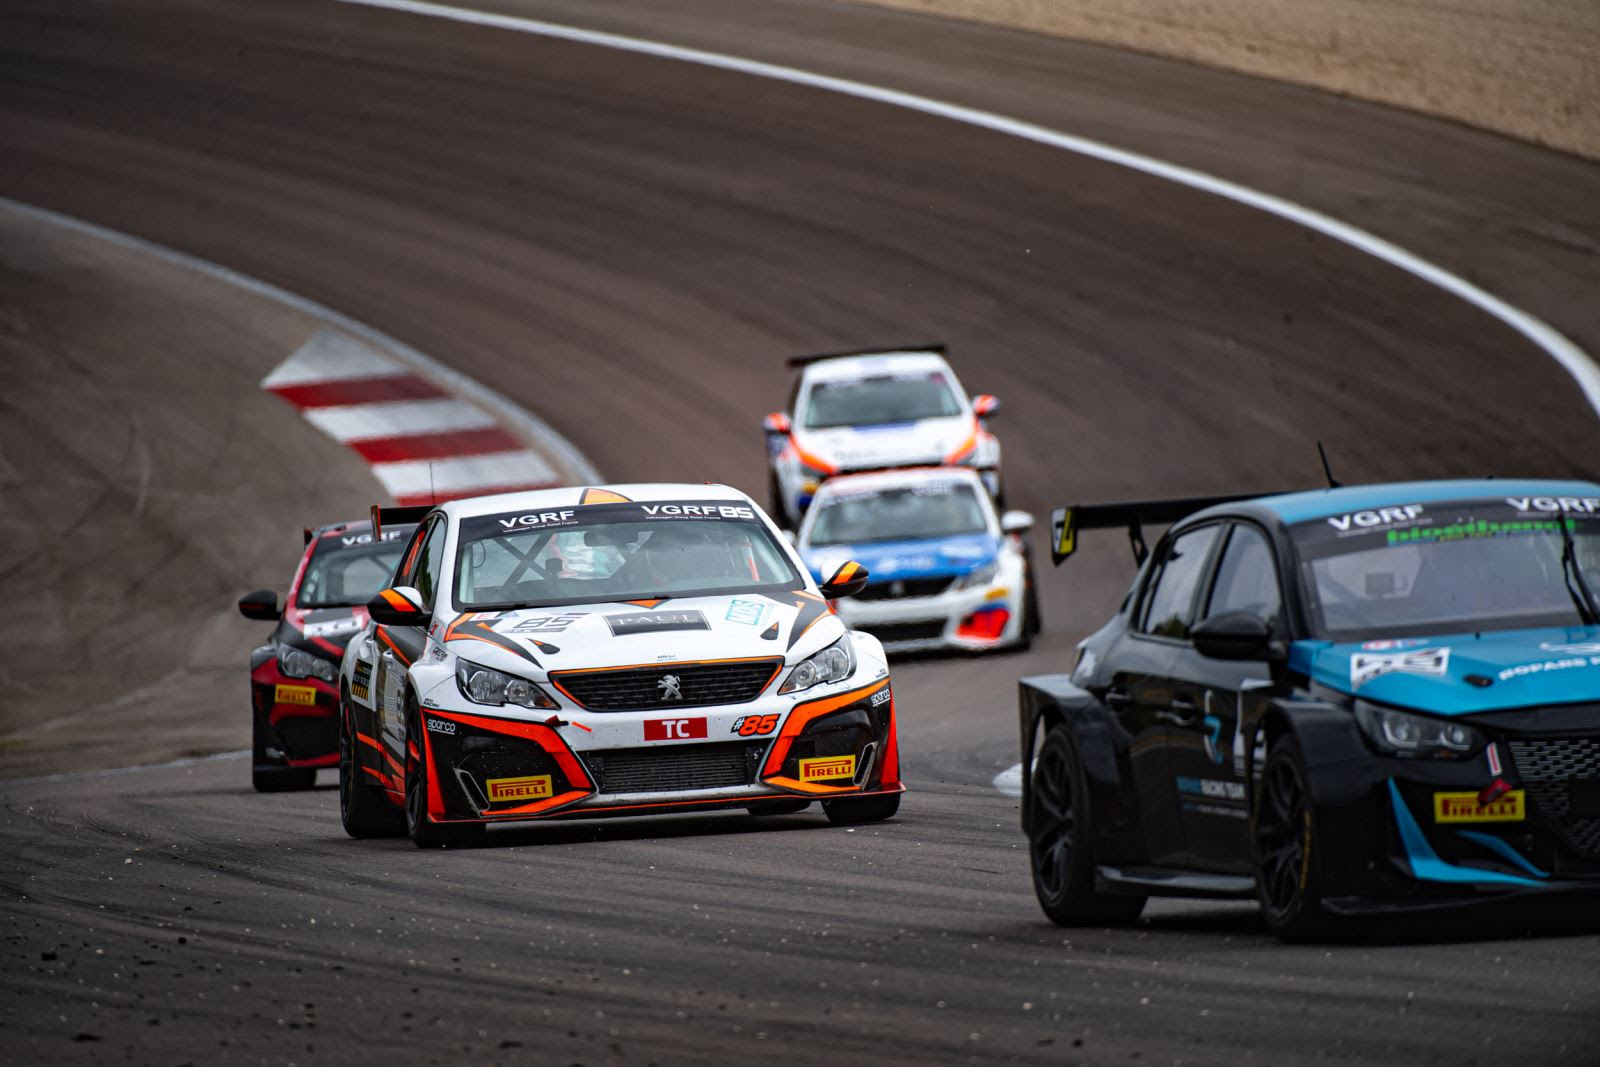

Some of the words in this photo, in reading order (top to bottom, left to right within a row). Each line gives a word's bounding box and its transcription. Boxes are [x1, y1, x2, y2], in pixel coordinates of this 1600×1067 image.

[498, 510, 575, 528] VGRF
[641, 505, 717, 516] VGRF
[718, 505, 755, 520] 85
[1327, 504, 1424, 531] VGRF
[618, 613, 697, 625] PAUL
[871, 688, 891, 705] sparco
[427, 718, 456, 734] sparco
[662, 719, 690, 739] TC
[732, 713, 781, 737] #85
[803, 759, 853, 778] PIRELLI
[491, 779, 547, 798] PIRELLI
